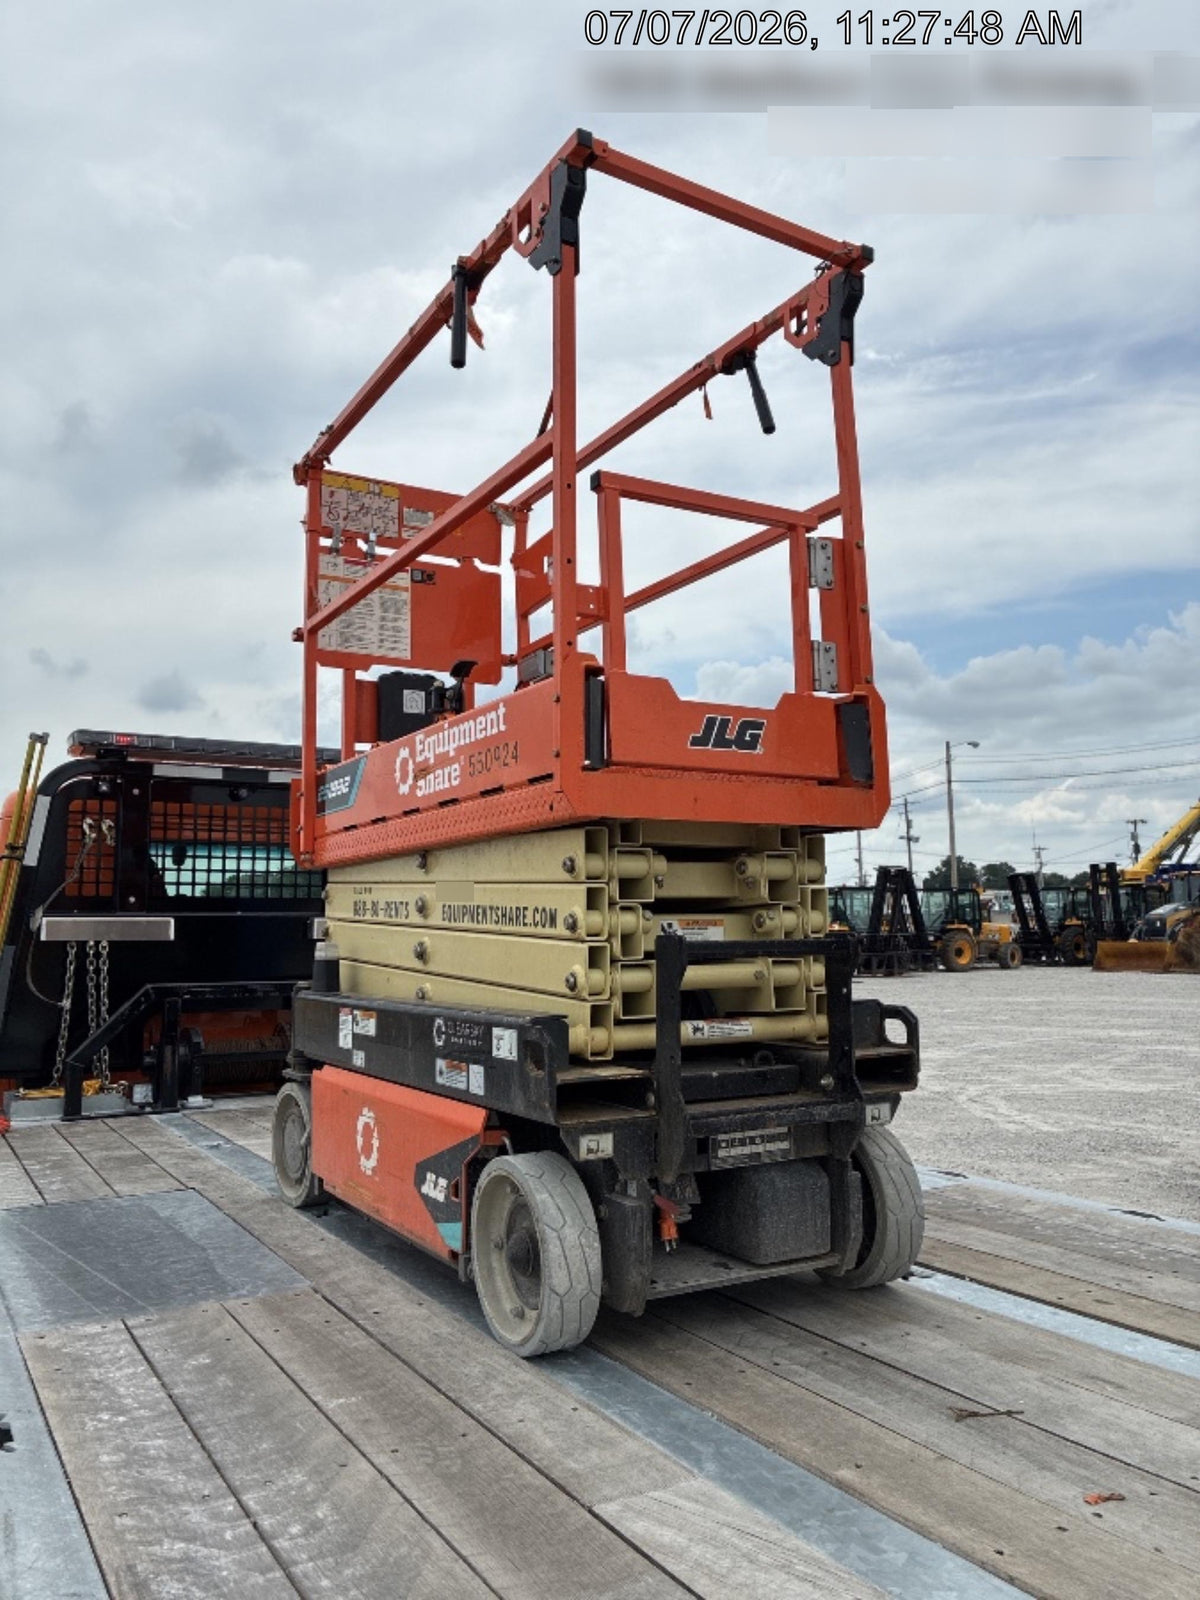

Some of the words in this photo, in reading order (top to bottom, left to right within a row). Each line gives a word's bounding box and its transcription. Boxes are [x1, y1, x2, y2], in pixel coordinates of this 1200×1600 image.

[415, 702, 507, 765] Equipment
[687, 714, 767, 754] JLG
[441, 903, 558, 929] EQUIPMENTSHARE.COM
[421, 1171, 448, 1202] JLG
